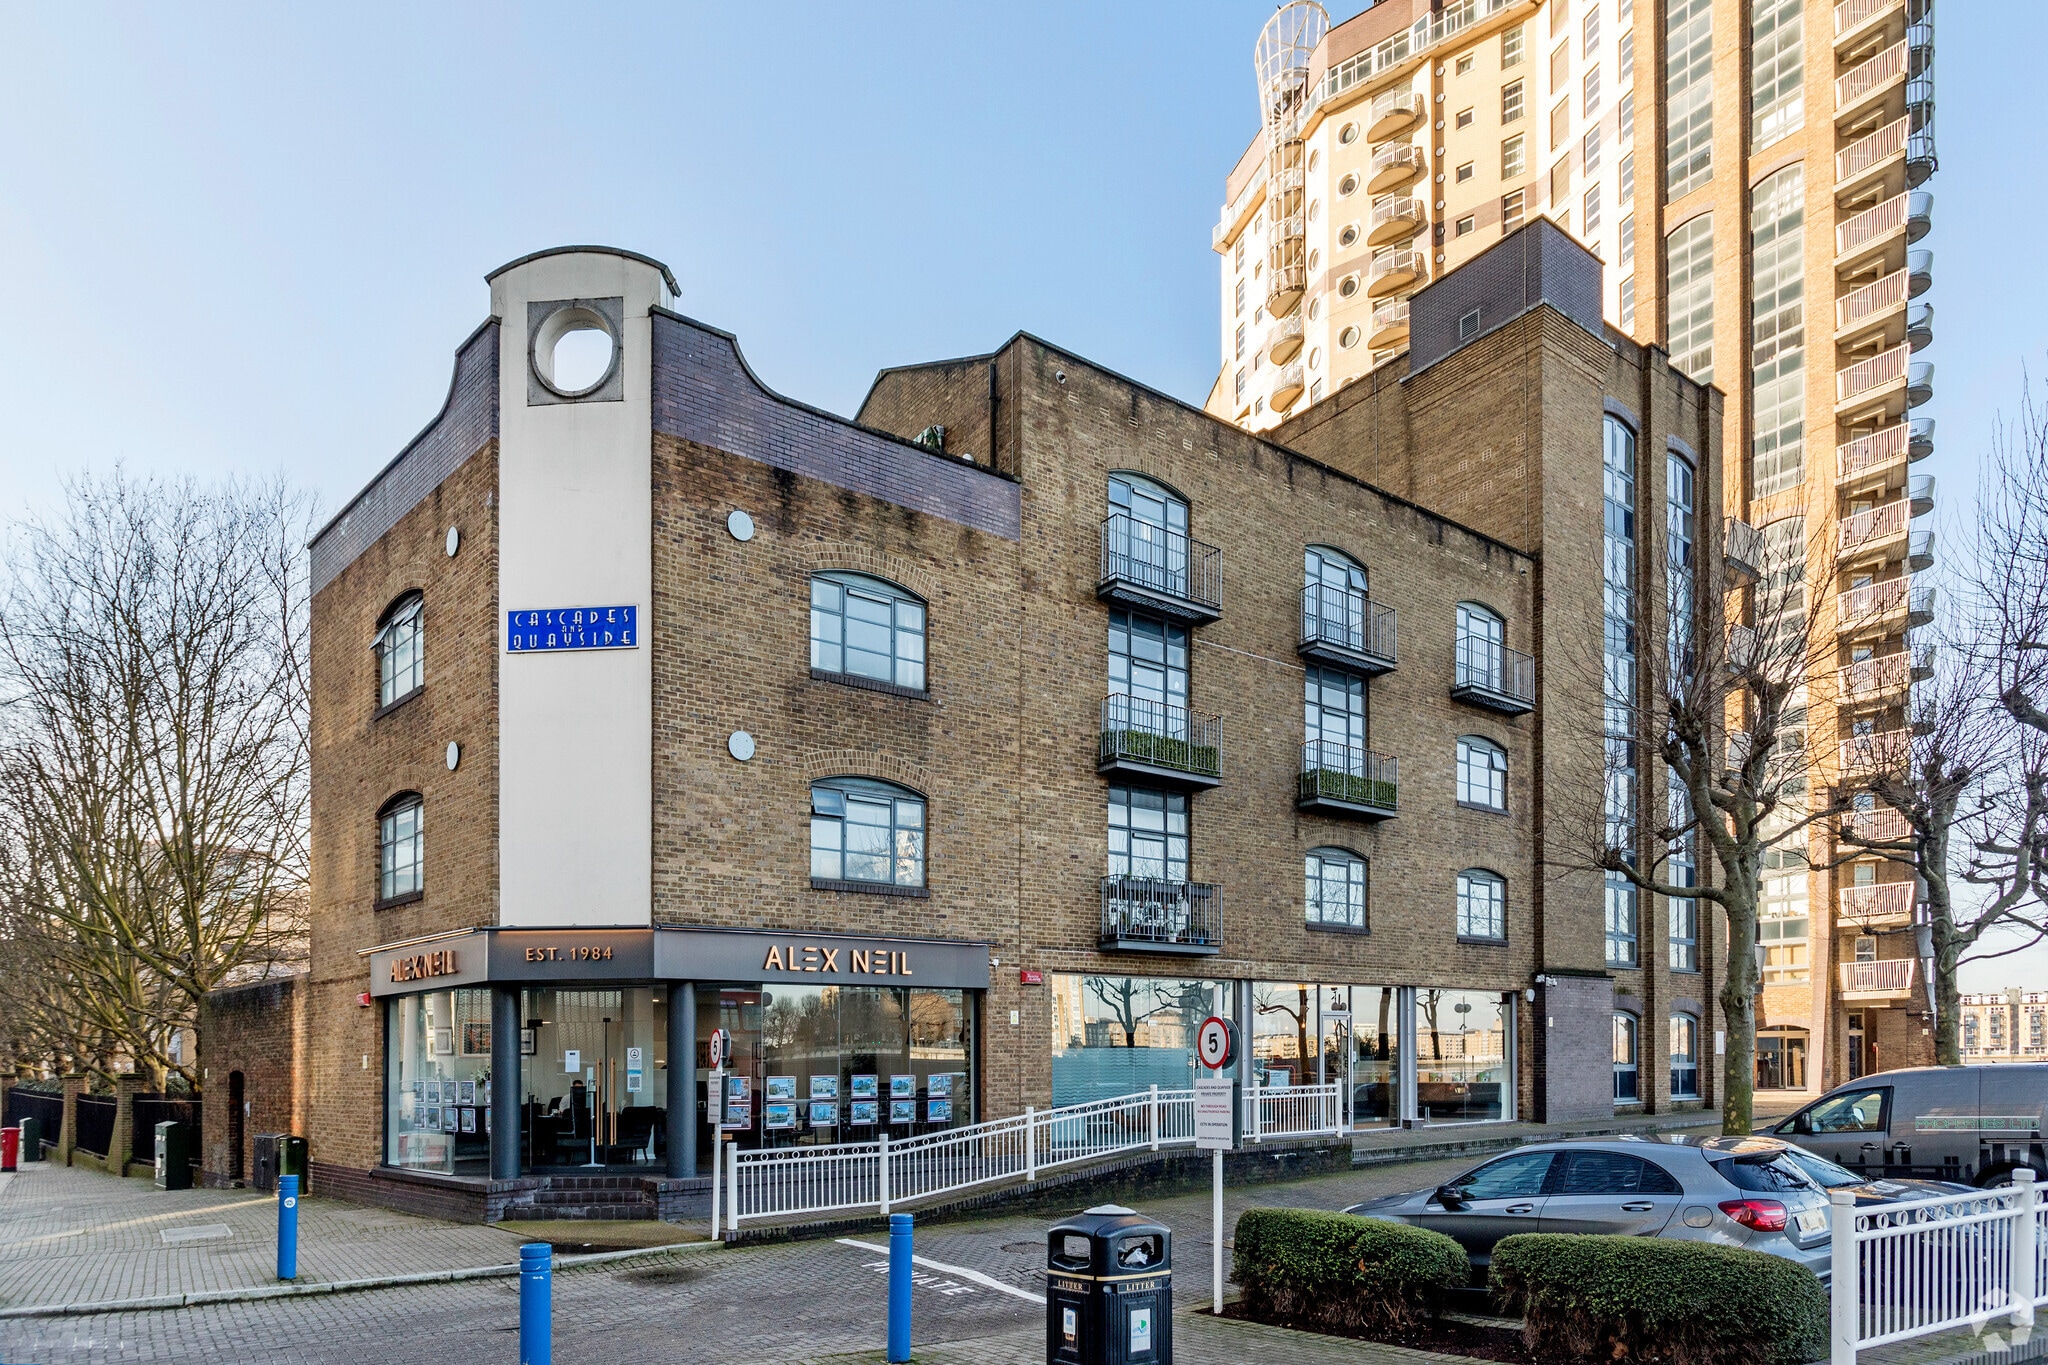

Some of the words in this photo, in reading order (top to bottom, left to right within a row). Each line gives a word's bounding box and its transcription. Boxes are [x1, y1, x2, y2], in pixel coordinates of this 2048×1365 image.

[514, 608, 629, 627] CASCADES
[561, 625, 583, 633] AND
[513, 630, 631, 650] QUAYSIDE
[525, 947, 564, 962] EST.
[569, 946, 613, 961] 1984
[763, 945, 839, 972] ALEX
[851, 949, 913, 975] NEIL
[390, 955, 424, 982] ALEX
[424, 950, 459, 978] NEIL
[713, 1040, 718, 1056] 5
[1208, 1033, 1218, 1054] 5
[1915, 1118, 2006, 1129] PROPERTIES
[2009, 1118, 2040, 1129] LTD
[1057, 1279, 1083, 1291] LITTER
[1126, 1281, 1156, 1291] LITTER
